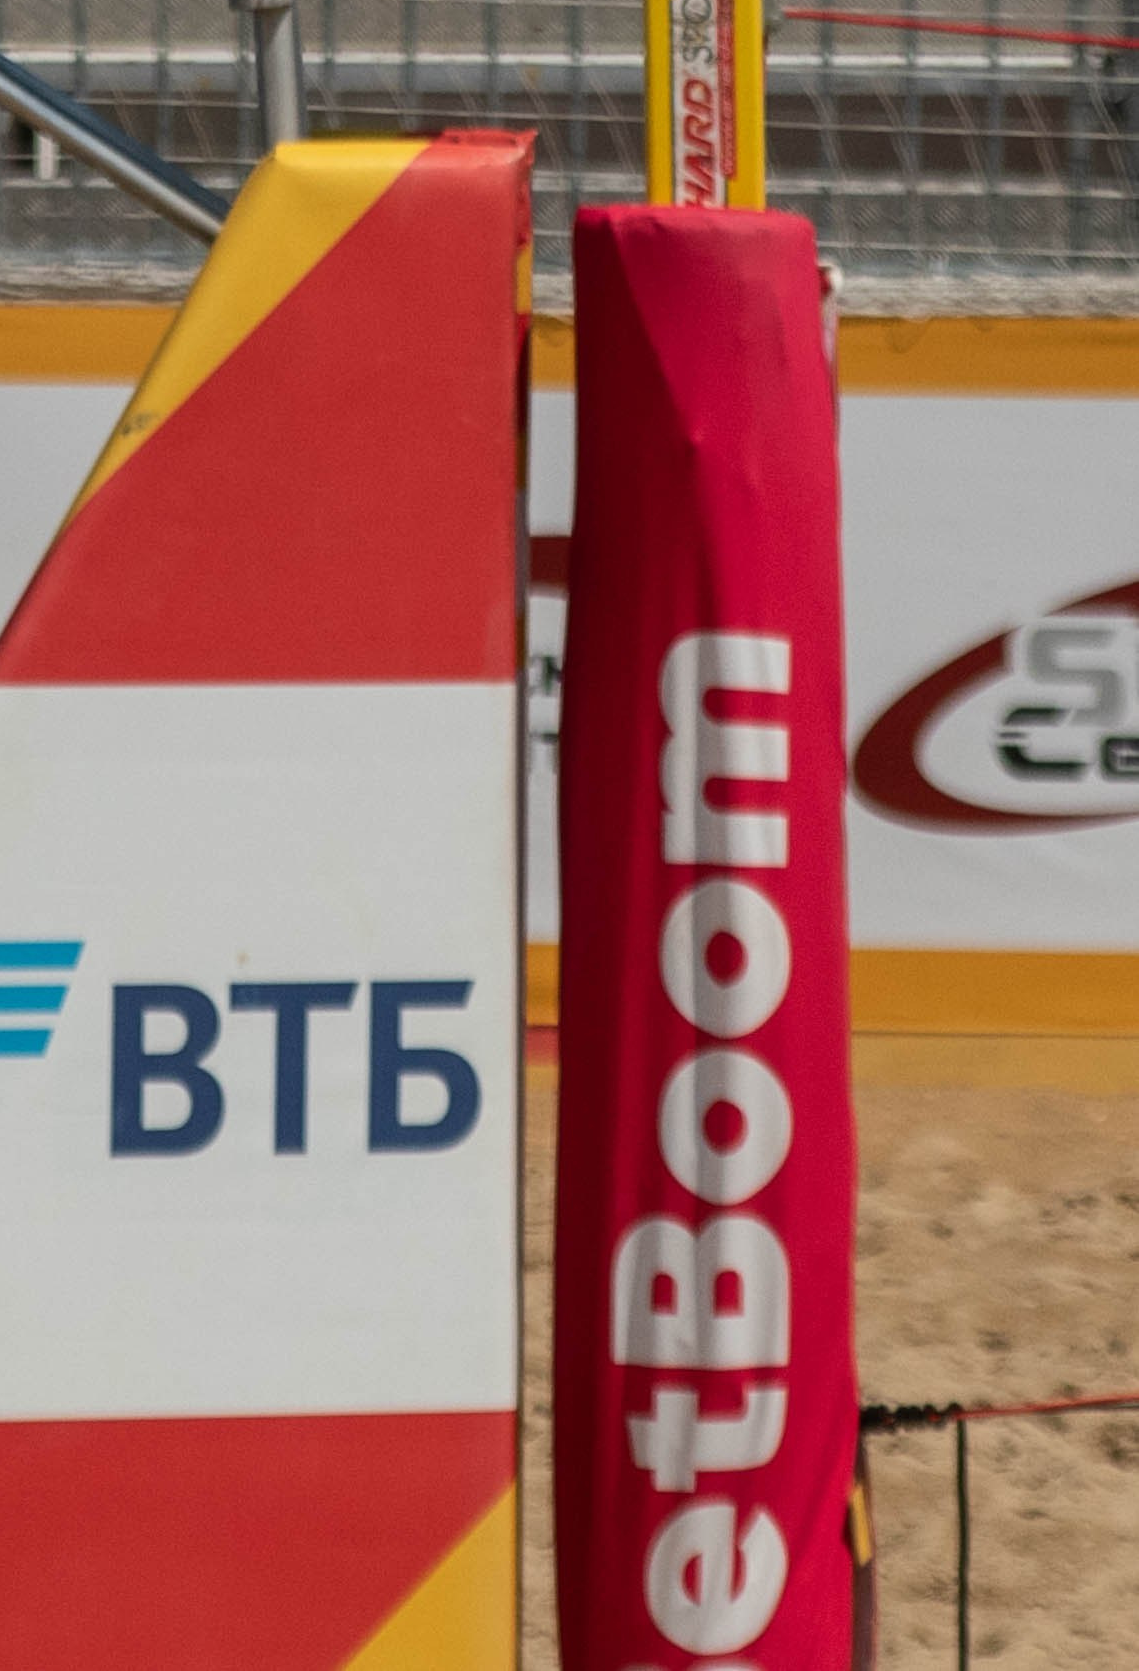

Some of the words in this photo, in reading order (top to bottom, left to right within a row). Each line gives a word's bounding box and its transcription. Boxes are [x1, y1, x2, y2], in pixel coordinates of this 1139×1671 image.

[683, 79, 714, 208] HARD
[109, 981, 482, 1157] ВТБ
[610, 631, 794, 1671] etBoom
